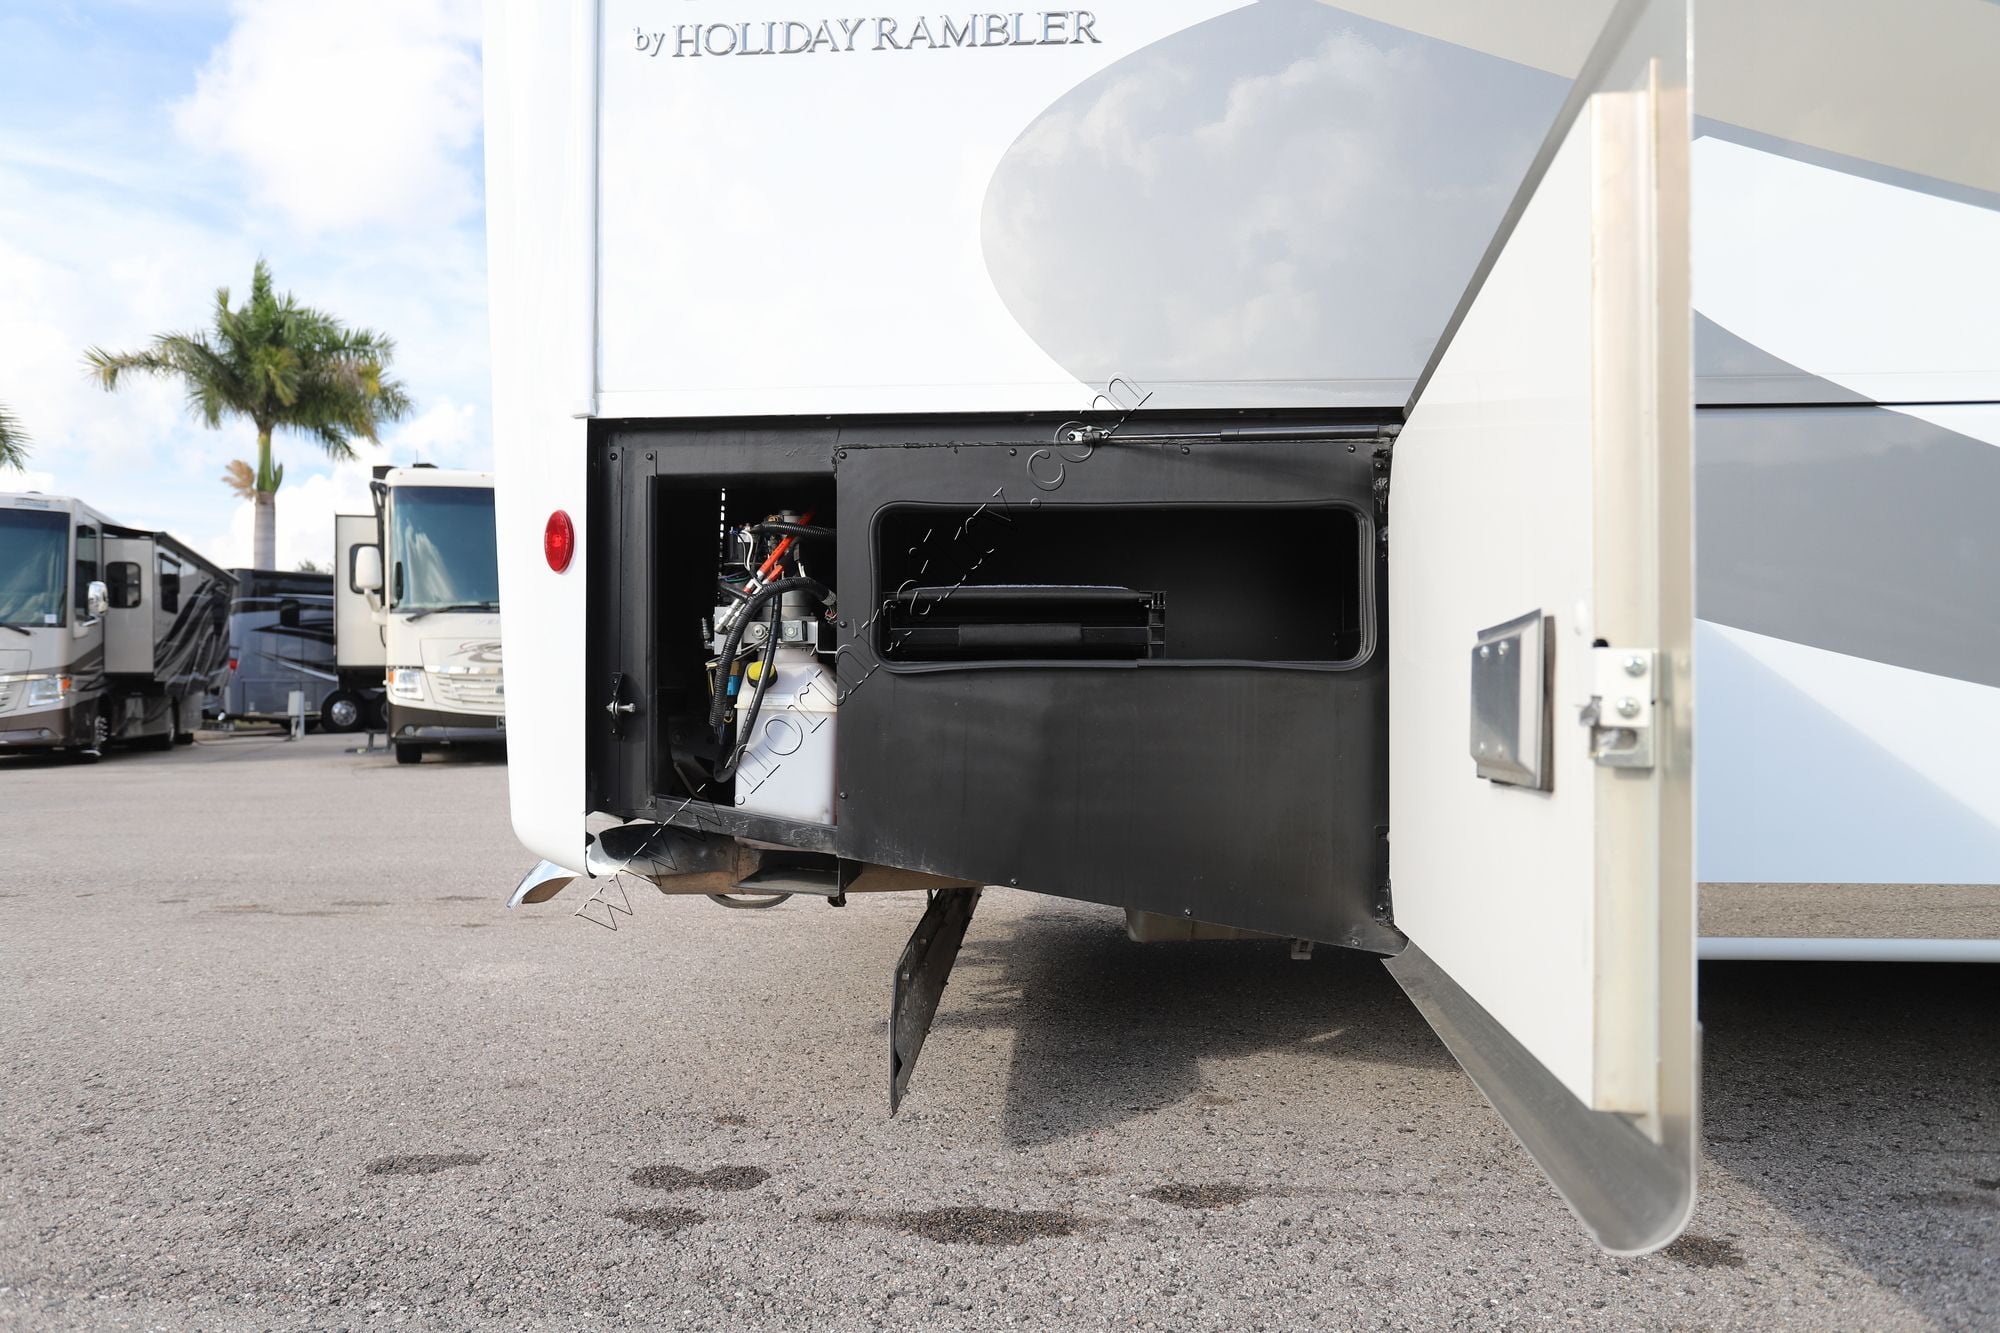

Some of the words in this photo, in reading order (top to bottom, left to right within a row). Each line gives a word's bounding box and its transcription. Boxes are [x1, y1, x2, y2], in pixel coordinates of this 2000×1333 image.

[633, 26, 666, 57] by
[672, 17, 866, 57] HOLIDAY
[871, 10, 1103, 51] RAMBLER
